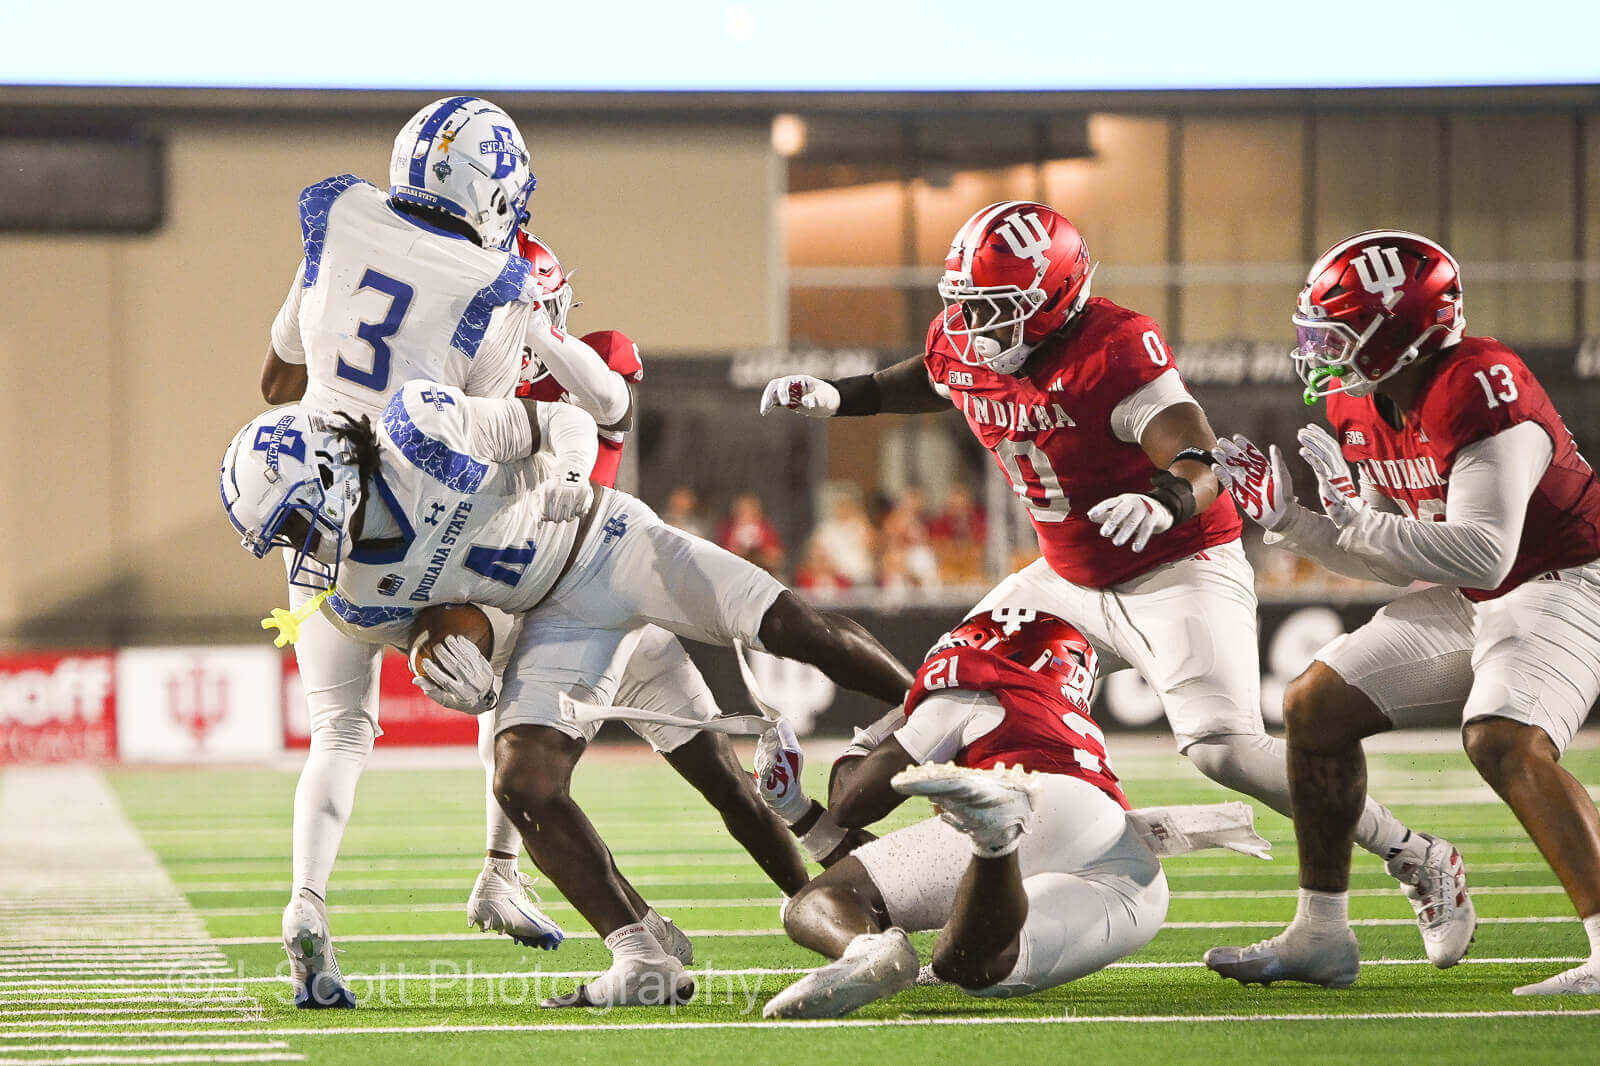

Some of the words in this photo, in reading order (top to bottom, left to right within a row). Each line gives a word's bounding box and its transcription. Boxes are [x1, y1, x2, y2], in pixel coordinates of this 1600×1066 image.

[336, 265, 415, 393] 3
[1142, 330, 1167, 366] 0
[1473, 363, 1519, 408] 13
[962, 391, 1077, 432] INDIANA
[995, 437, 1071, 522] 0
[441, 501, 473, 545] STATE
[464, 539, 536, 588] 4
[924, 655, 960, 691] 21
